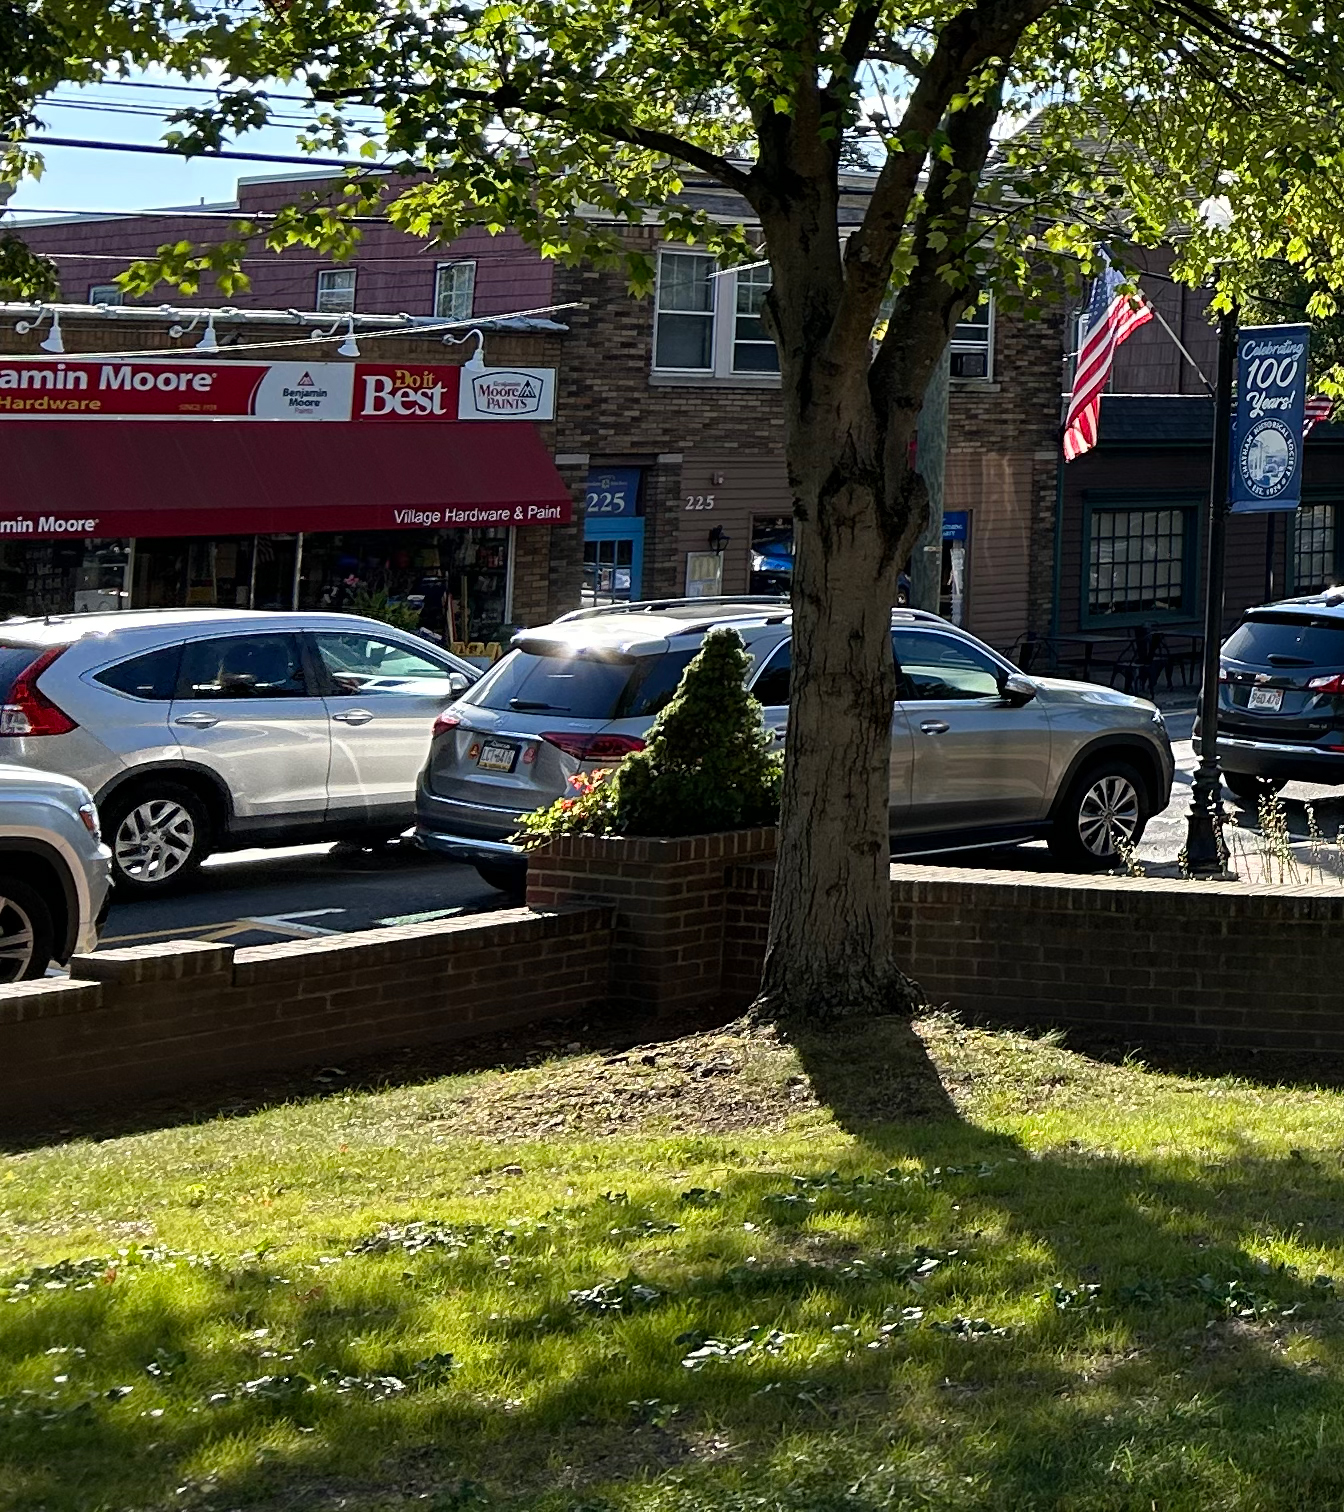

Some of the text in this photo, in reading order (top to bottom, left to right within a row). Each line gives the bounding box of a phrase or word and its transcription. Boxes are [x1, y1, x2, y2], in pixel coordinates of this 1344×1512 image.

[1242, 340, 1304, 361] Celebrating
[395, 369, 435, 387] Do it
[1246, 358, 1298, 389] 100
[283, 387, 328, 399] Benjamin
[361, 375, 447, 416] Best
[479, 384, 520, 398] Moore
[289, 398, 321, 407] Moore
[486, 397, 528, 409] PAINTS
[1246, 390, 1295, 418] Years!
[587, 492, 625, 514] 225
[685, 494, 715, 510] 225
[38, 516, 95, 532] Moore
[394, 504, 561, 526] Village Hardware & Paint
